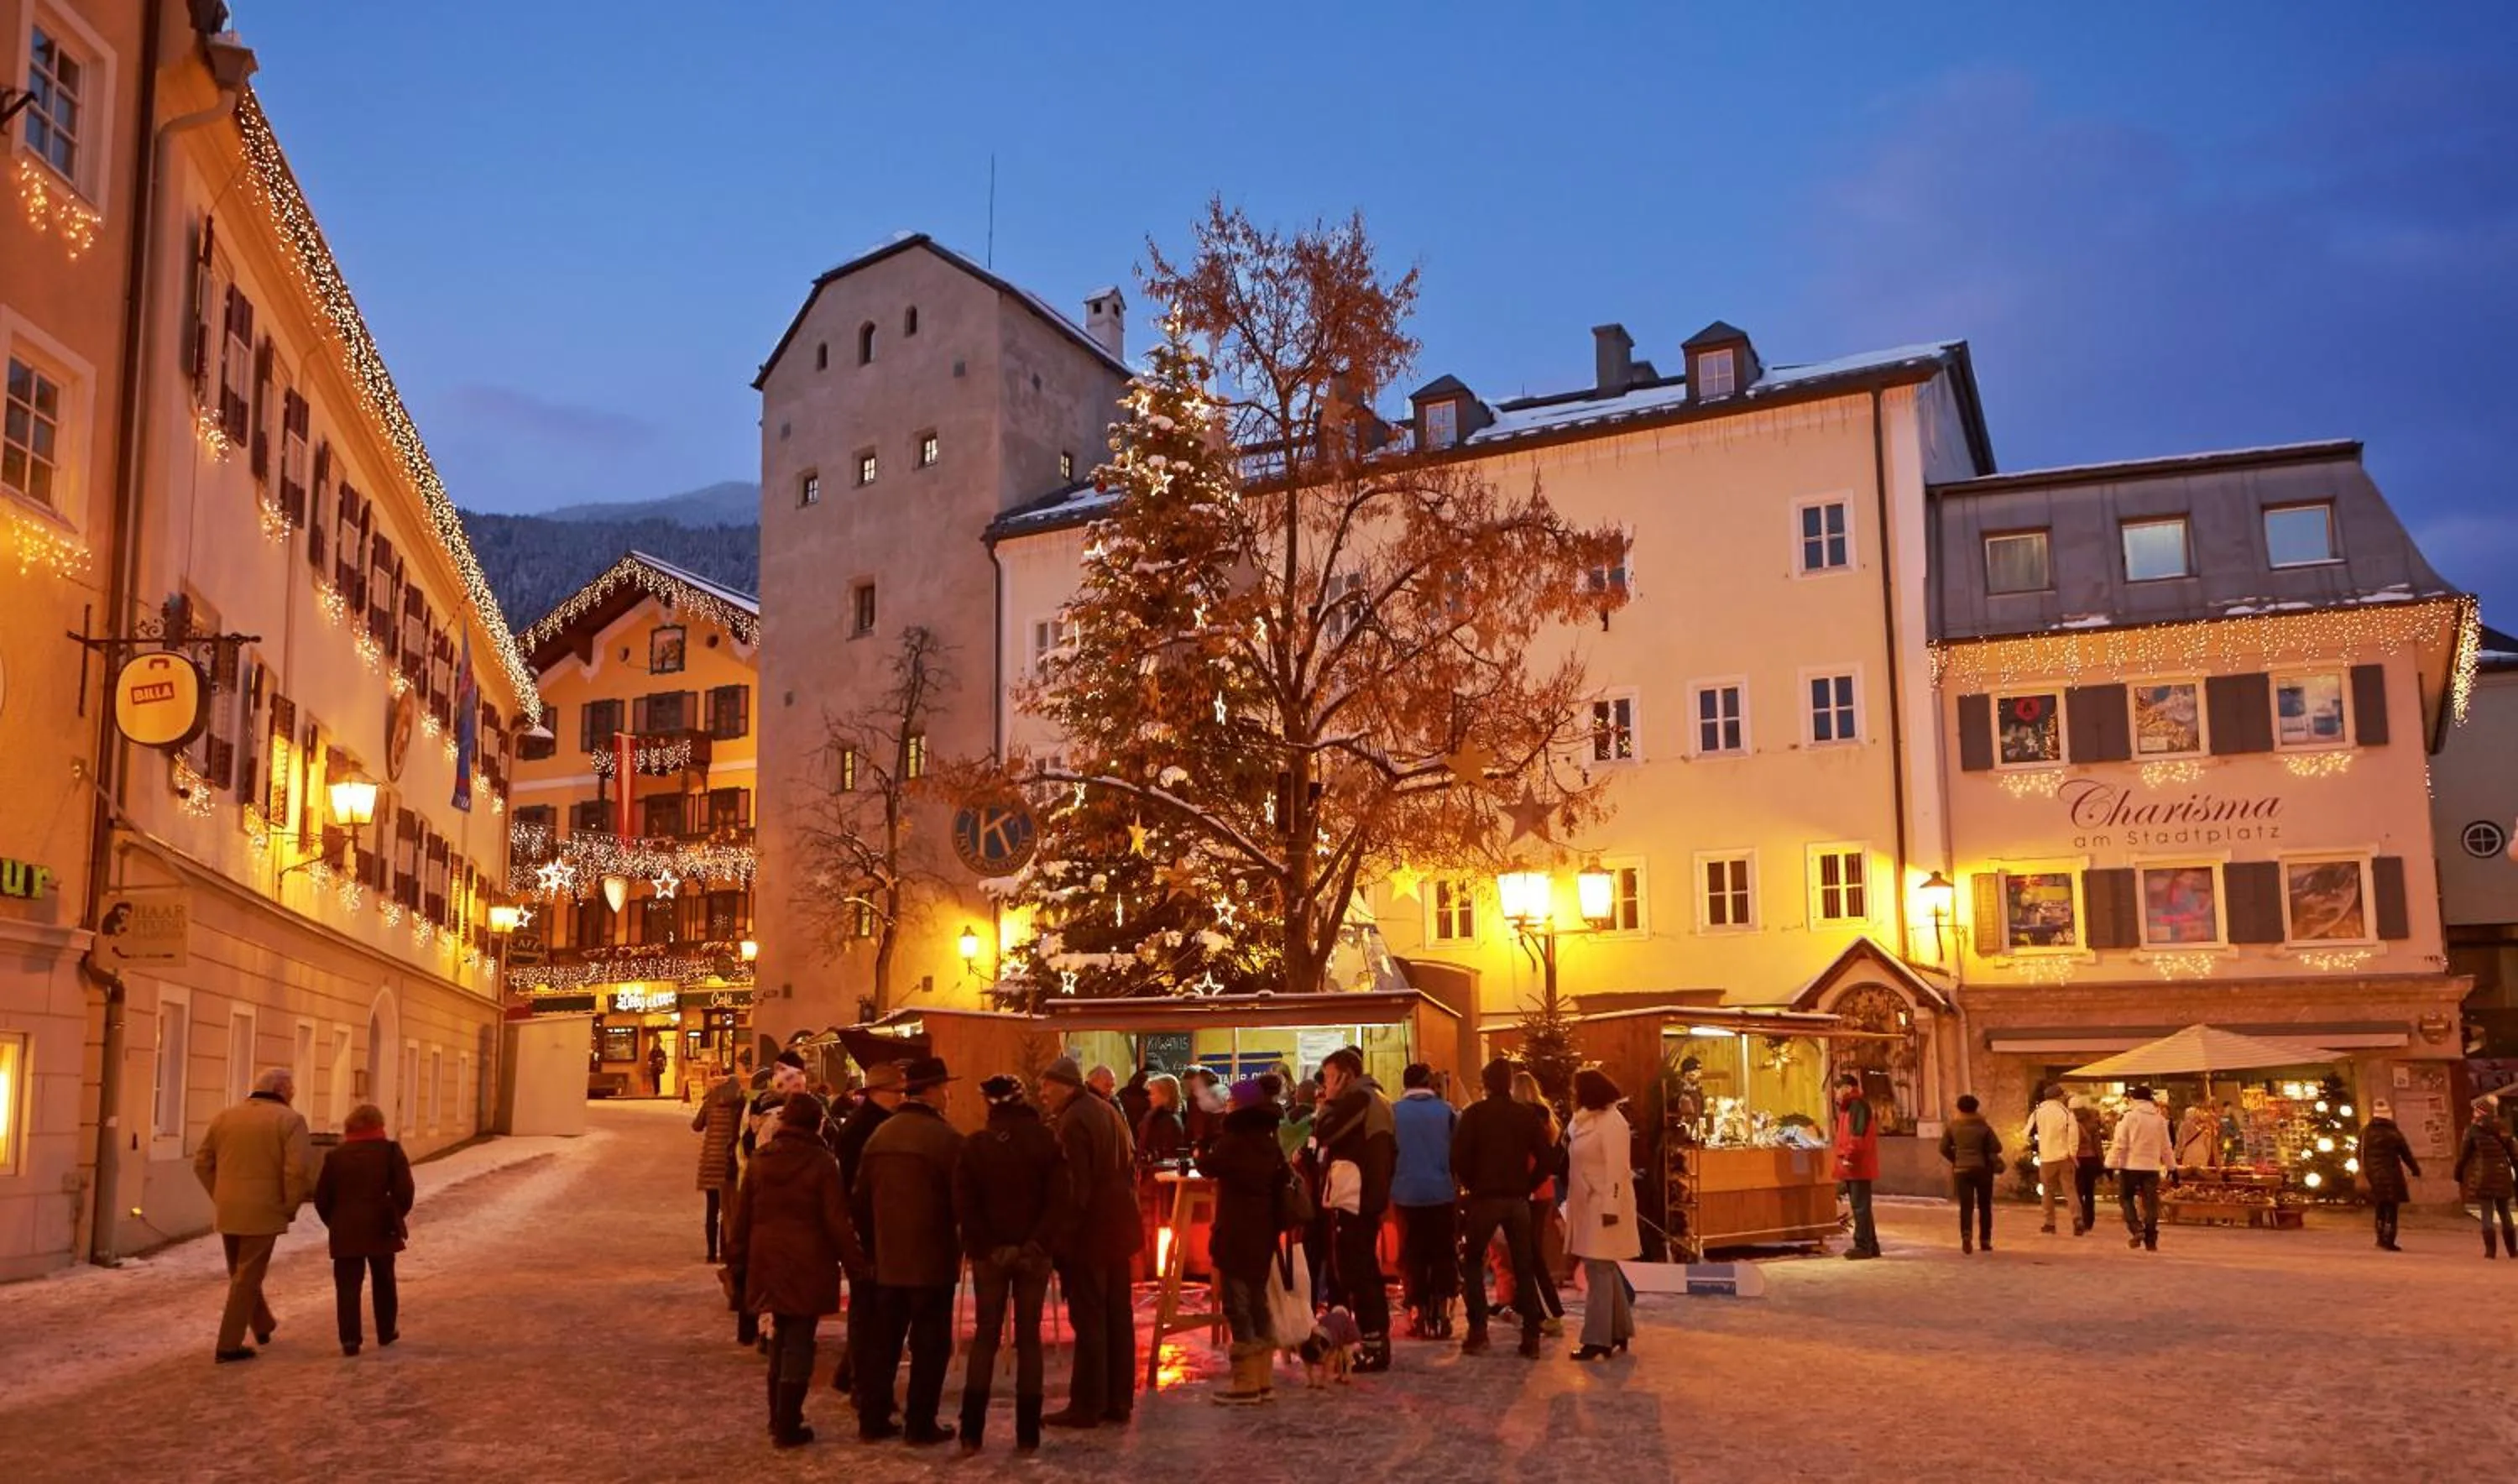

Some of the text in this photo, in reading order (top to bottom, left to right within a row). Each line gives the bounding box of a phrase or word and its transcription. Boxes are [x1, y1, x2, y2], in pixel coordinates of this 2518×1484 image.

[133, 684, 173, 703] BILLA
[2057, 779, 2281, 829] Charisma
[978, 807, 1013, 855] K
[2073, 826, 2281, 849] am Stadtplatz
[134, 904, 185, 918] HAAR
